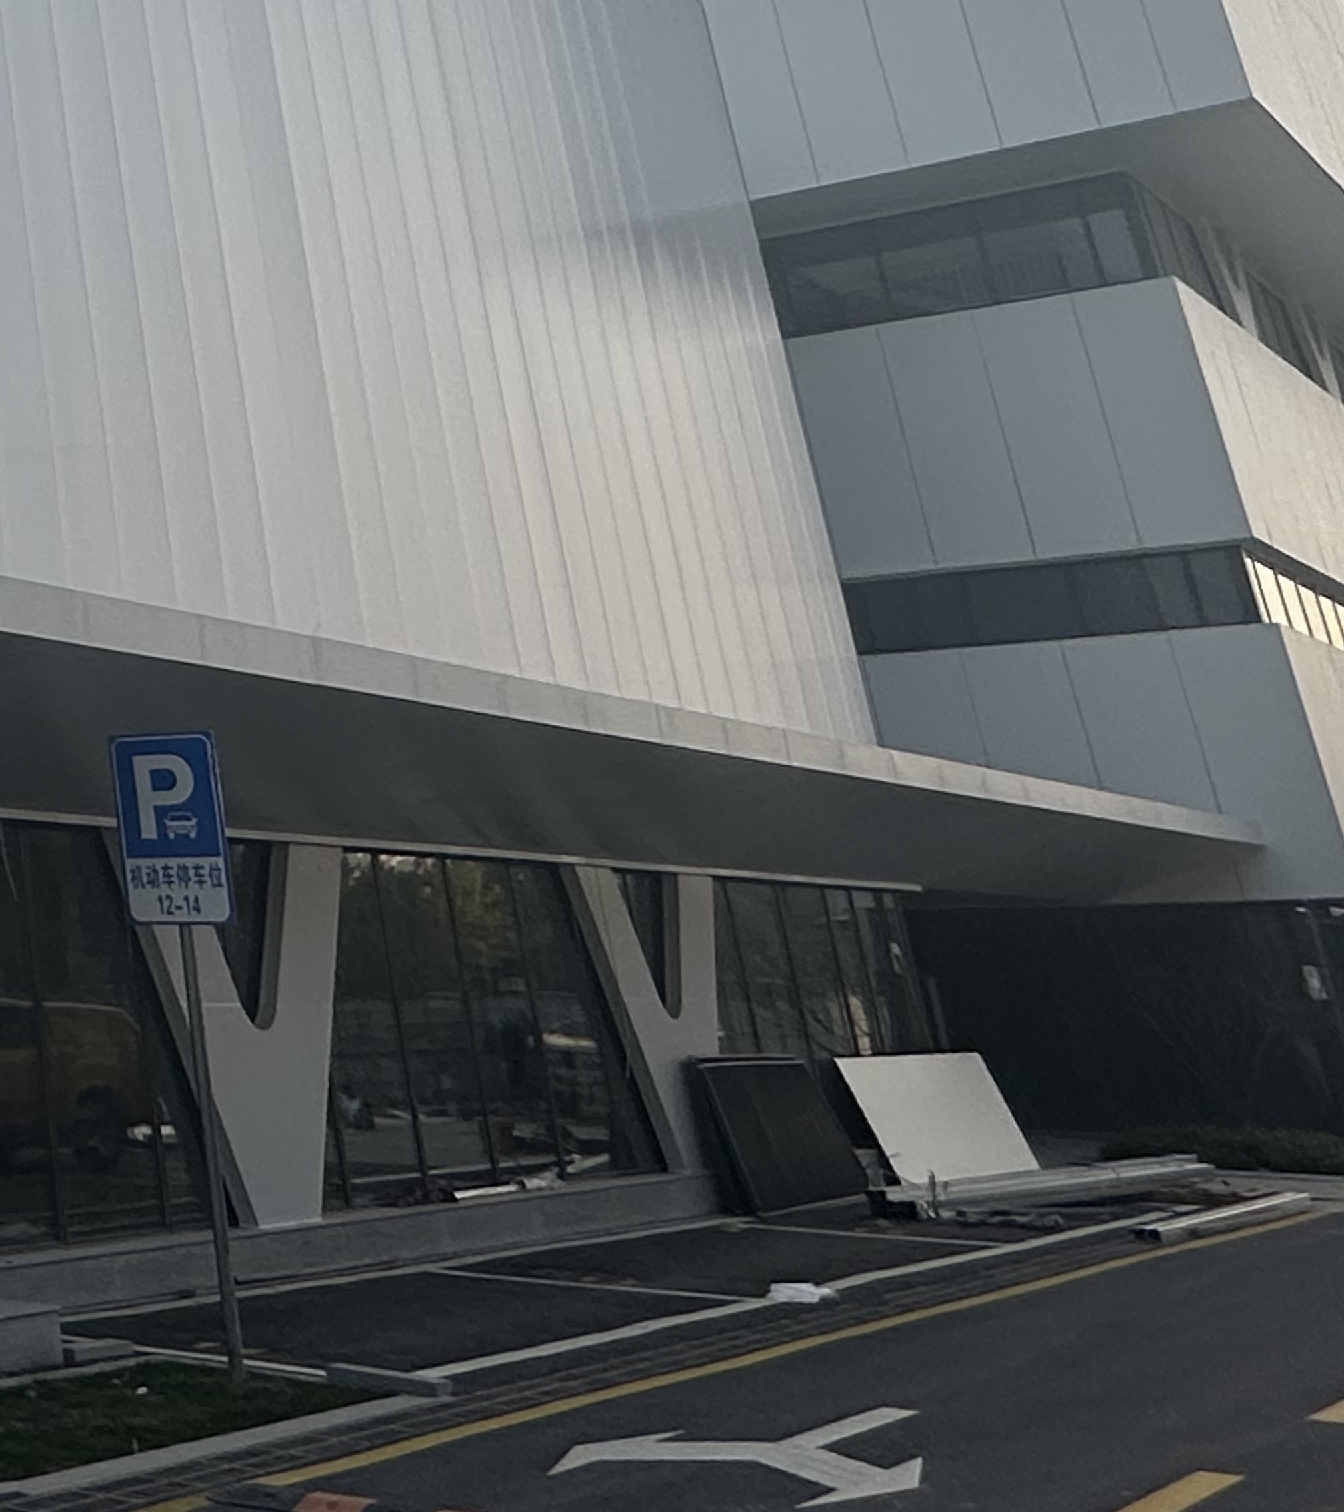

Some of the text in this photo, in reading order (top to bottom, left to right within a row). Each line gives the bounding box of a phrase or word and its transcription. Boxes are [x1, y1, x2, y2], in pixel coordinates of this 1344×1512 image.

[132, 754, 195, 840] P
[129, 862, 224, 890] 机动车停车位
[157, 894, 202, 916] 12-14
